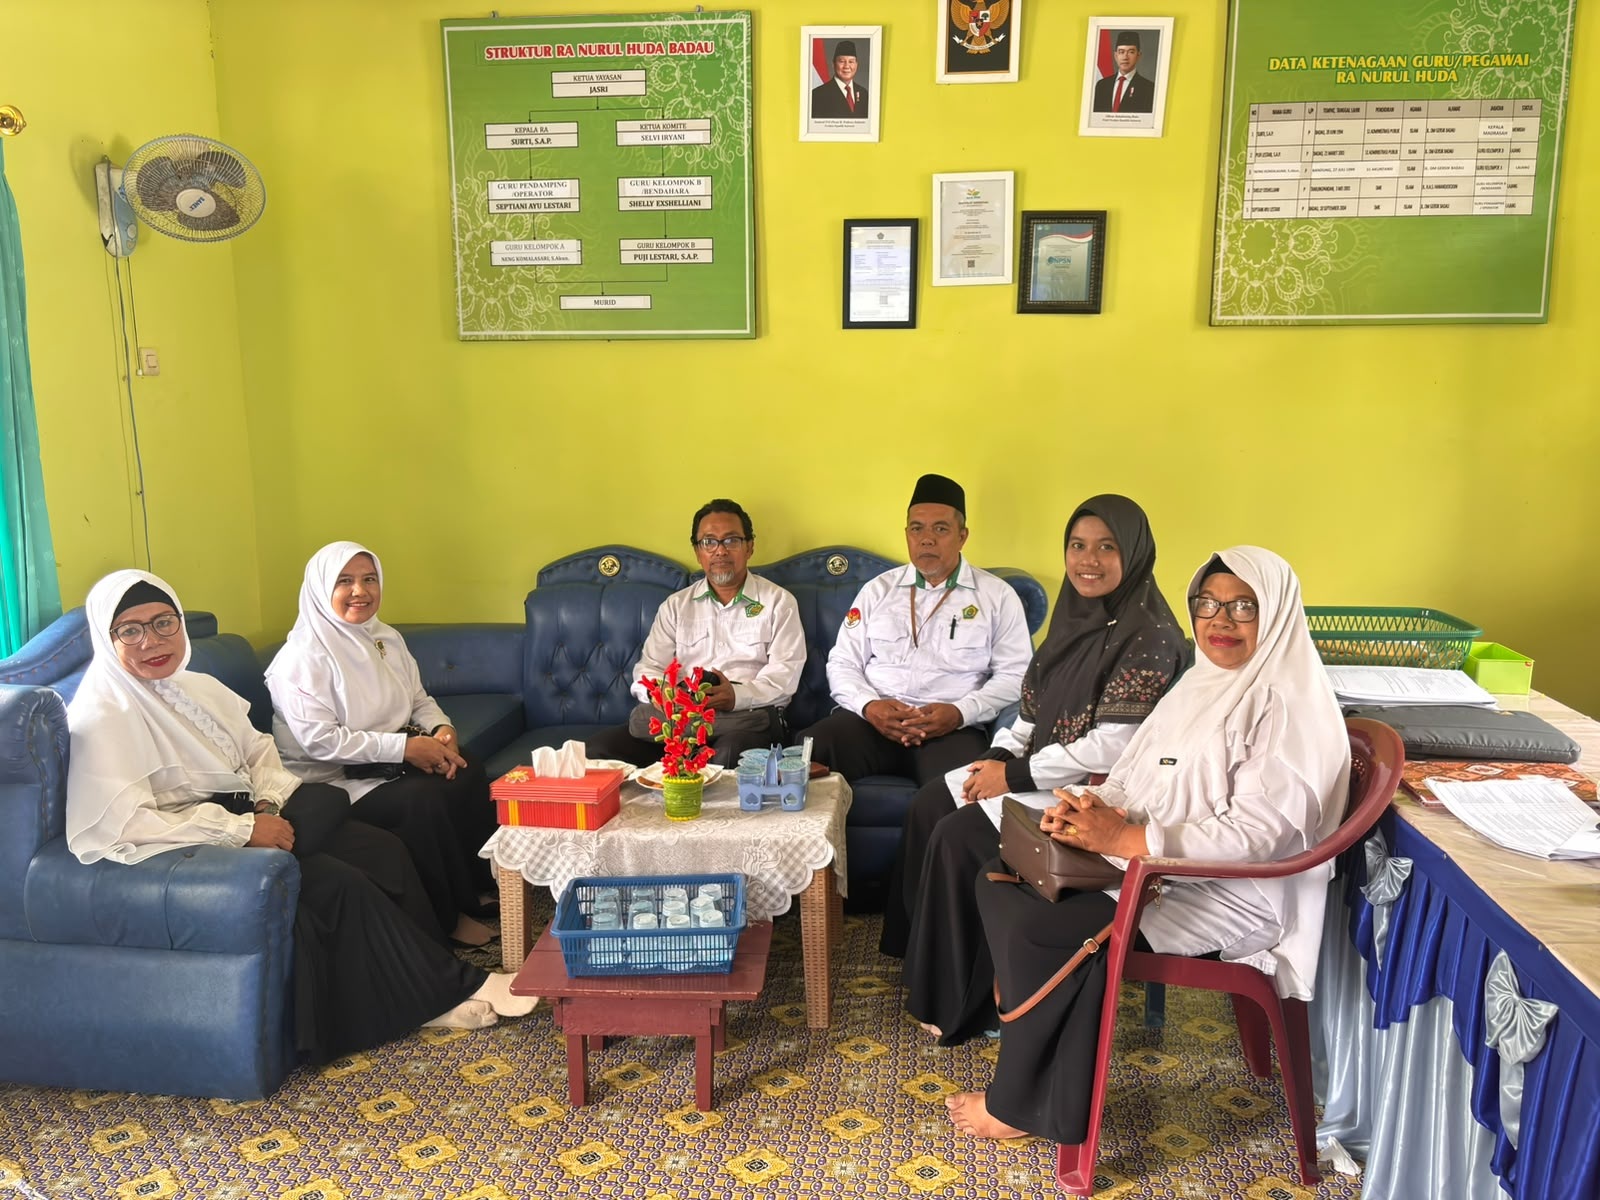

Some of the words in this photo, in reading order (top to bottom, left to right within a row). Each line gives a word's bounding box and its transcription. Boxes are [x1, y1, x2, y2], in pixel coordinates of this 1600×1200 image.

[485, 45, 552, 60] STRUKTUR
[556, 45, 575, 57] RA
[578, 44, 624, 57] NURUL
[627, 43, 664, 56] HUDA
[669, 41, 715, 55] BADAU
[1269, 57, 1307, 71] DATA
[1312, 55, 1407, 69] KETENAGAAN
[1412, 53, 1529, 69] GURU/PEGAWAI
[573, 74, 595, 82] KETUA
[596, 73, 622, 81] YAYASAN
[1336, 71, 1356, 84] RA
[1361, 70, 1410, 83] NURUL
[1415, 70, 1458, 82] HUDA
[589, 86, 608, 94] JASRI
[515, 126, 539, 134] KEPALA
[511, 138, 533, 146] SURTI,
[534, 137, 552, 145] S.A.P.
[641, 134, 660, 142] SELVI
[498, 182, 517, 190] GURU
[519, 181, 567, 189] PENDAMPING
[630, 179, 650, 187] GURU
[512, 190, 554, 198] /OPERATOR
[641, 187, 690, 195] /BENDAHARA
[495, 202, 528, 210] SEPTIANI
[656, 199, 701, 207] EXSHELLIANI
[505, 243, 522, 251] GURU
[654, 241, 688, 249] KELOMPOK
[634, 253, 648, 261] PUJI
[649, 253, 679, 261] LESTARI,
